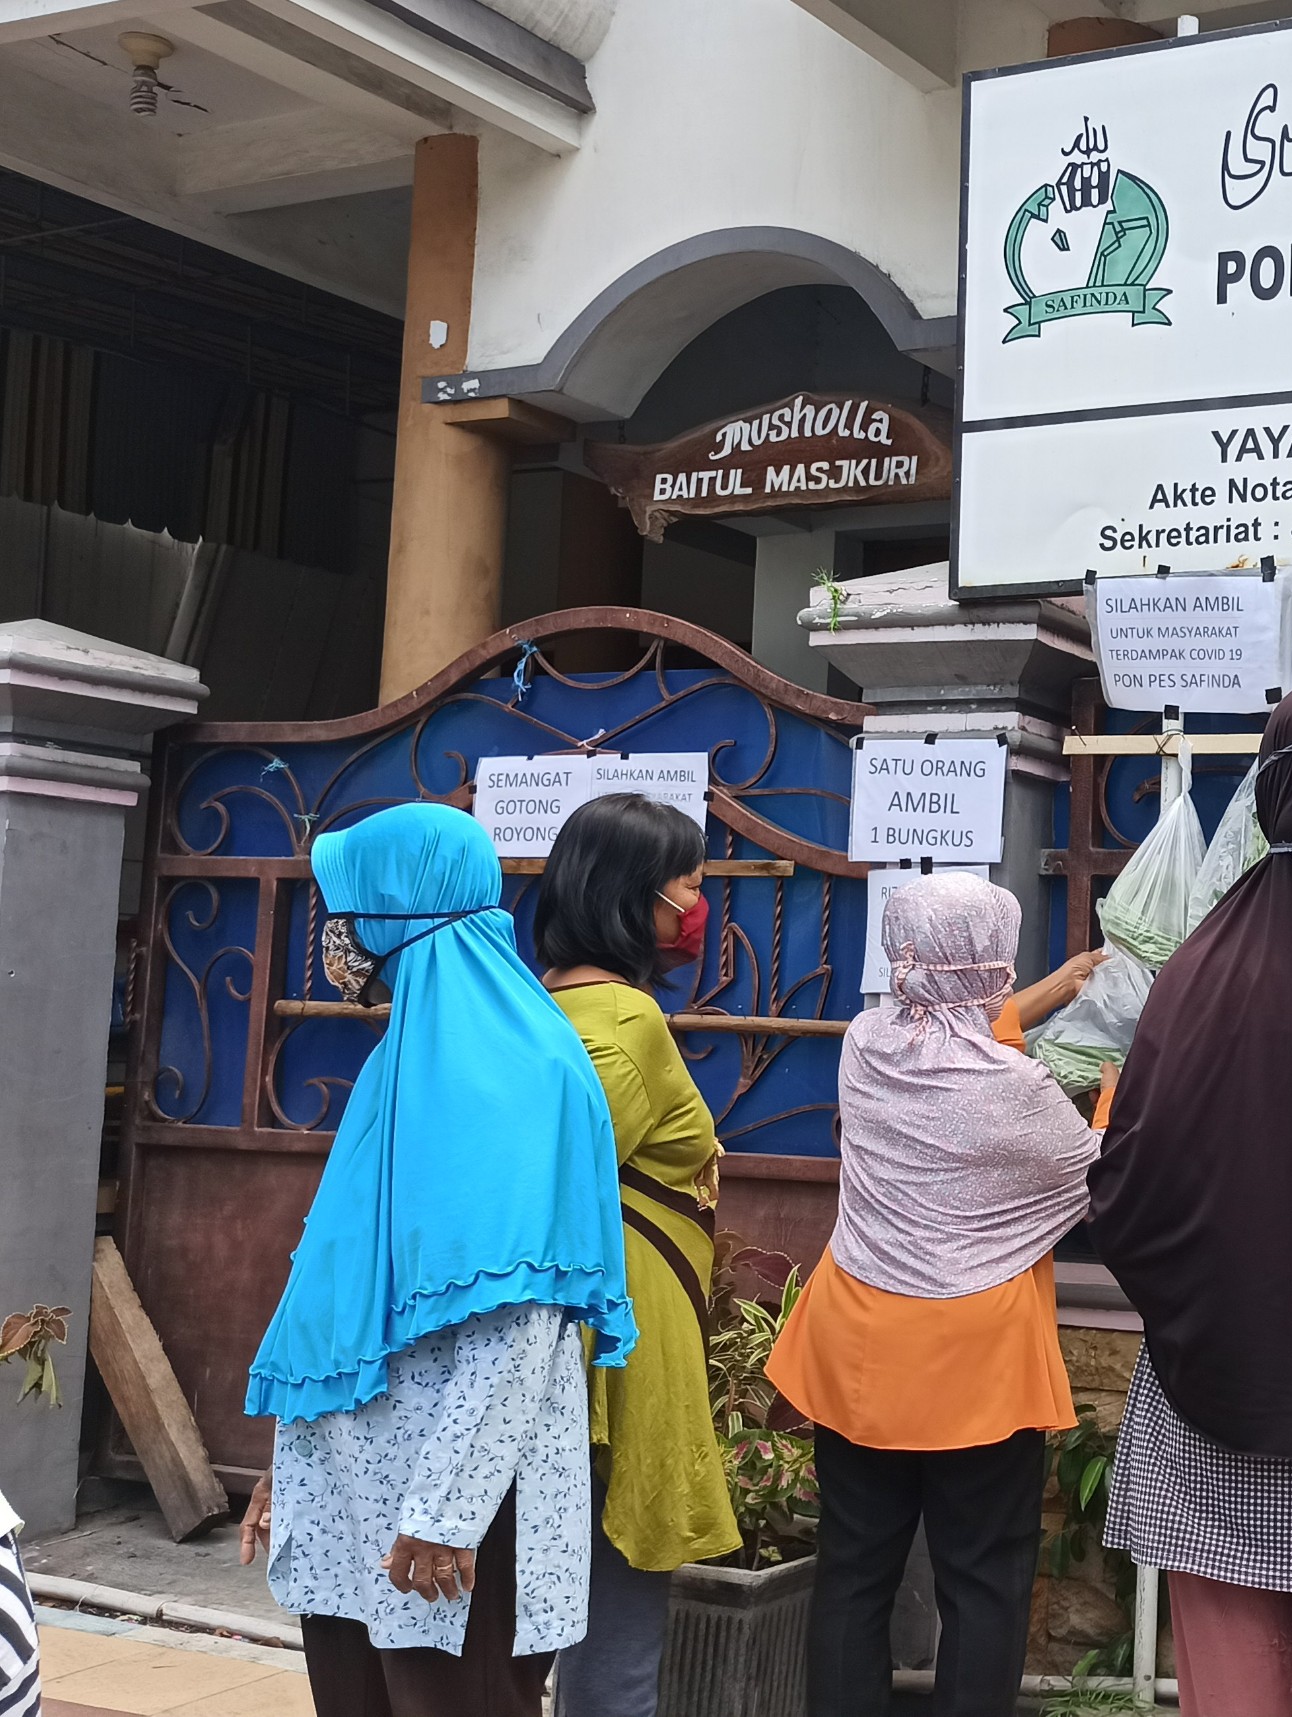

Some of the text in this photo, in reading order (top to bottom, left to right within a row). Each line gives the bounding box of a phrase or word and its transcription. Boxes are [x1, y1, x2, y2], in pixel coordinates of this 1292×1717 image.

[1044, 291, 1130, 314] SAFINDA
[653, 455, 918, 501] BAITUL MASJKURI
[1149, 482, 1216, 509] Akte
[1099, 517, 1261, 551] Sekretariat
[1274, 521, 1279, 540] :
[1106, 596, 1243, 613] SILAHKAN AMBIL
[1111, 626, 1239, 639] UNTUK MASYARAKAT
[1109, 649, 1242, 660] TERDAMPAK COVID 19
[1114, 674, 1241, 688] PON PES SAFINDA
[596, 768, 696, 782] SILAHKAN AMBIL
[869, 758, 985, 777] SATU ORANG
[488, 772, 572, 788] SEMANGAT
[495, 799, 560, 815] GOTONG
[888, 791, 959, 814] AMBIL
[494, 827, 555, 841] ROYONG
[871, 827, 973, 847] 1 BUNGKUS
